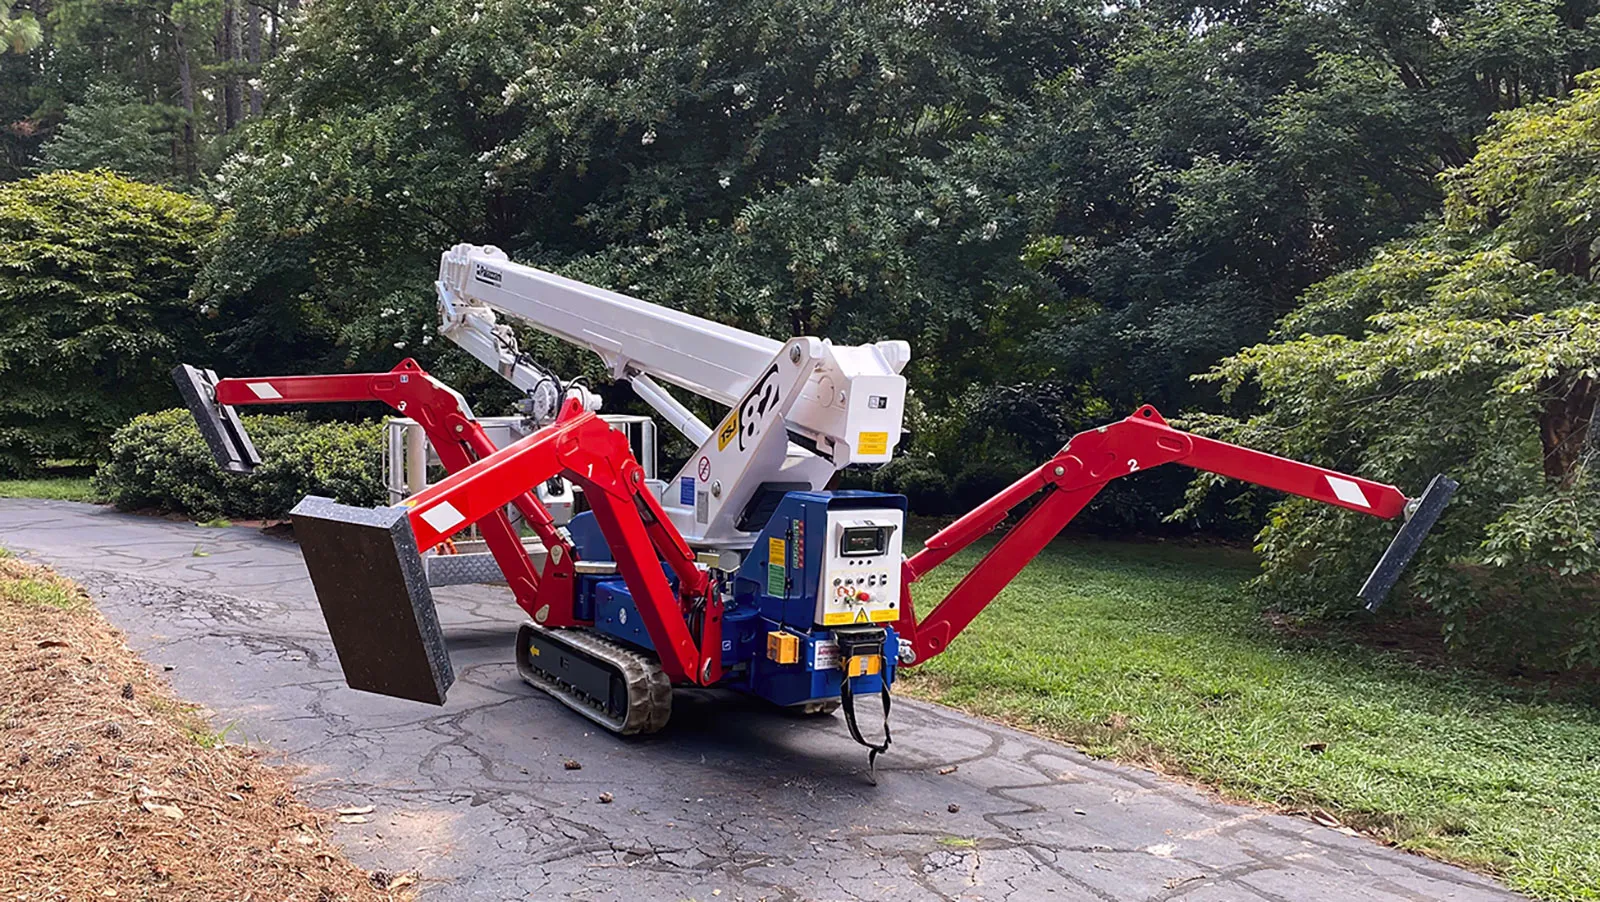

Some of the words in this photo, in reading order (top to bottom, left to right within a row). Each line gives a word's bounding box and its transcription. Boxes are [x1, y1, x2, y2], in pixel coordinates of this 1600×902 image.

[397, 400, 407, 411] 3
[721, 416, 738, 443] TSJ
[740, 365, 781, 450] 82
[587, 463, 594, 479] 1
[1127, 458, 1140, 472] 2
